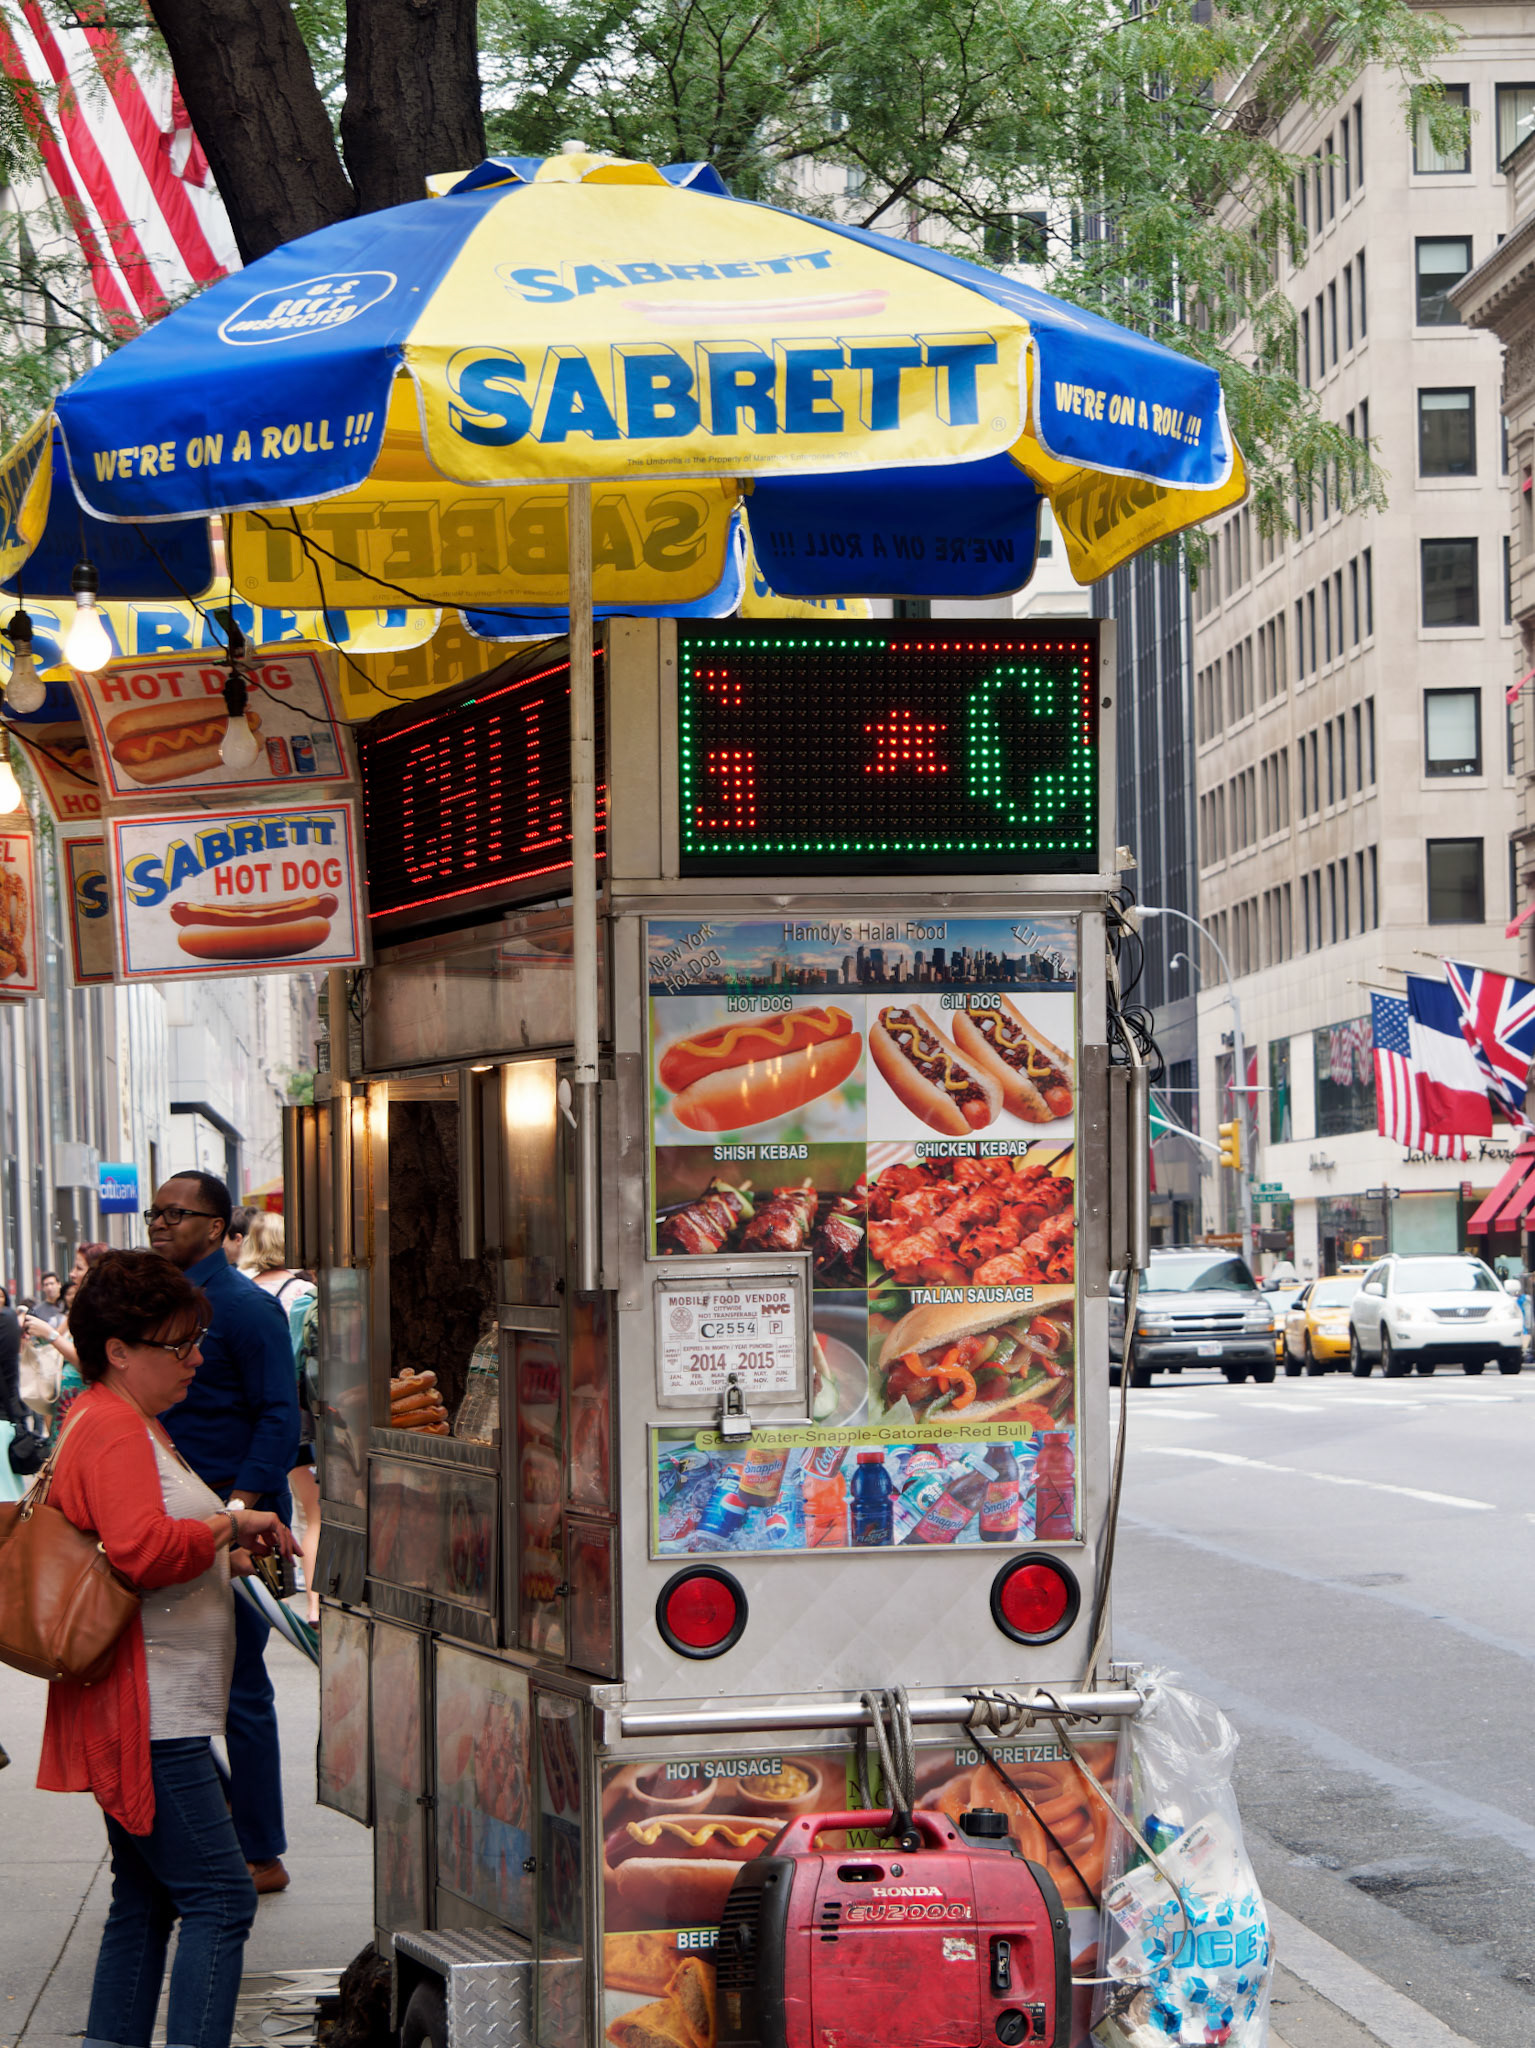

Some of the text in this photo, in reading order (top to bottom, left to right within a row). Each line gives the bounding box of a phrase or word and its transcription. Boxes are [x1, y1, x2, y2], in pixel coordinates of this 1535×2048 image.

[496, 249, 832, 303] SABRETT
[227, 305, 358, 333] INSPECTED
[447, 331, 998, 447] SABRETT
[1054, 381, 1107, 421] WE'RE
[1108, 394, 1135, 426] ON
[1138, 401, 1148, 430] A
[1152, 403, 1184, 440] ROLL
[93, 412, 374, 482] WE'RE ON A ROLL !!!
[708, 455, 743, 466] Property
[100, 672, 184, 702] HOT
[64, 794, 99, 814] HO
[125, 816, 336, 908] SABRETT
[215, 858, 342, 896] HOT DOG
[783, 922, 948, 946] Hamdy's Halal Food
[649, 923, 716, 976] New York
[664, 949, 722, 995] Hot Dog
[727, 995, 793, 1012] HOT DOG
[940, 993, 1001, 1010] CILI DOG
[713, 1144, 809, 1161] SHISH KEBAB
[915, 1140, 1028, 1159] CHICKEN KEBAB
[669, 1293, 787, 1306] MOBILE FOOD VENDOR
[910, 1286, 1033, 1305] ITALIAN SAUSAGE
[761, 1303, 791, 1316] NYC
[772, 1322, 780, 1332] P
[690, 1351, 775, 1372] 2014 2015
[998, 1425, 1027, 1436] Bull
[744, 1460, 783, 1475] Snapple
[983, 1492, 1019, 1514] Snapple
[927, 1510, 964, 1530] Snapple
[955, 1745, 1072, 1766] HOT PRETZELS
[666, 1758, 783, 1781] HOT SAUSAGE
[872, 1887, 943, 1897] HONDA
[677, 1930, 720, 1949] BEEF
[1171, 1924, 1258, 1969] ICE
